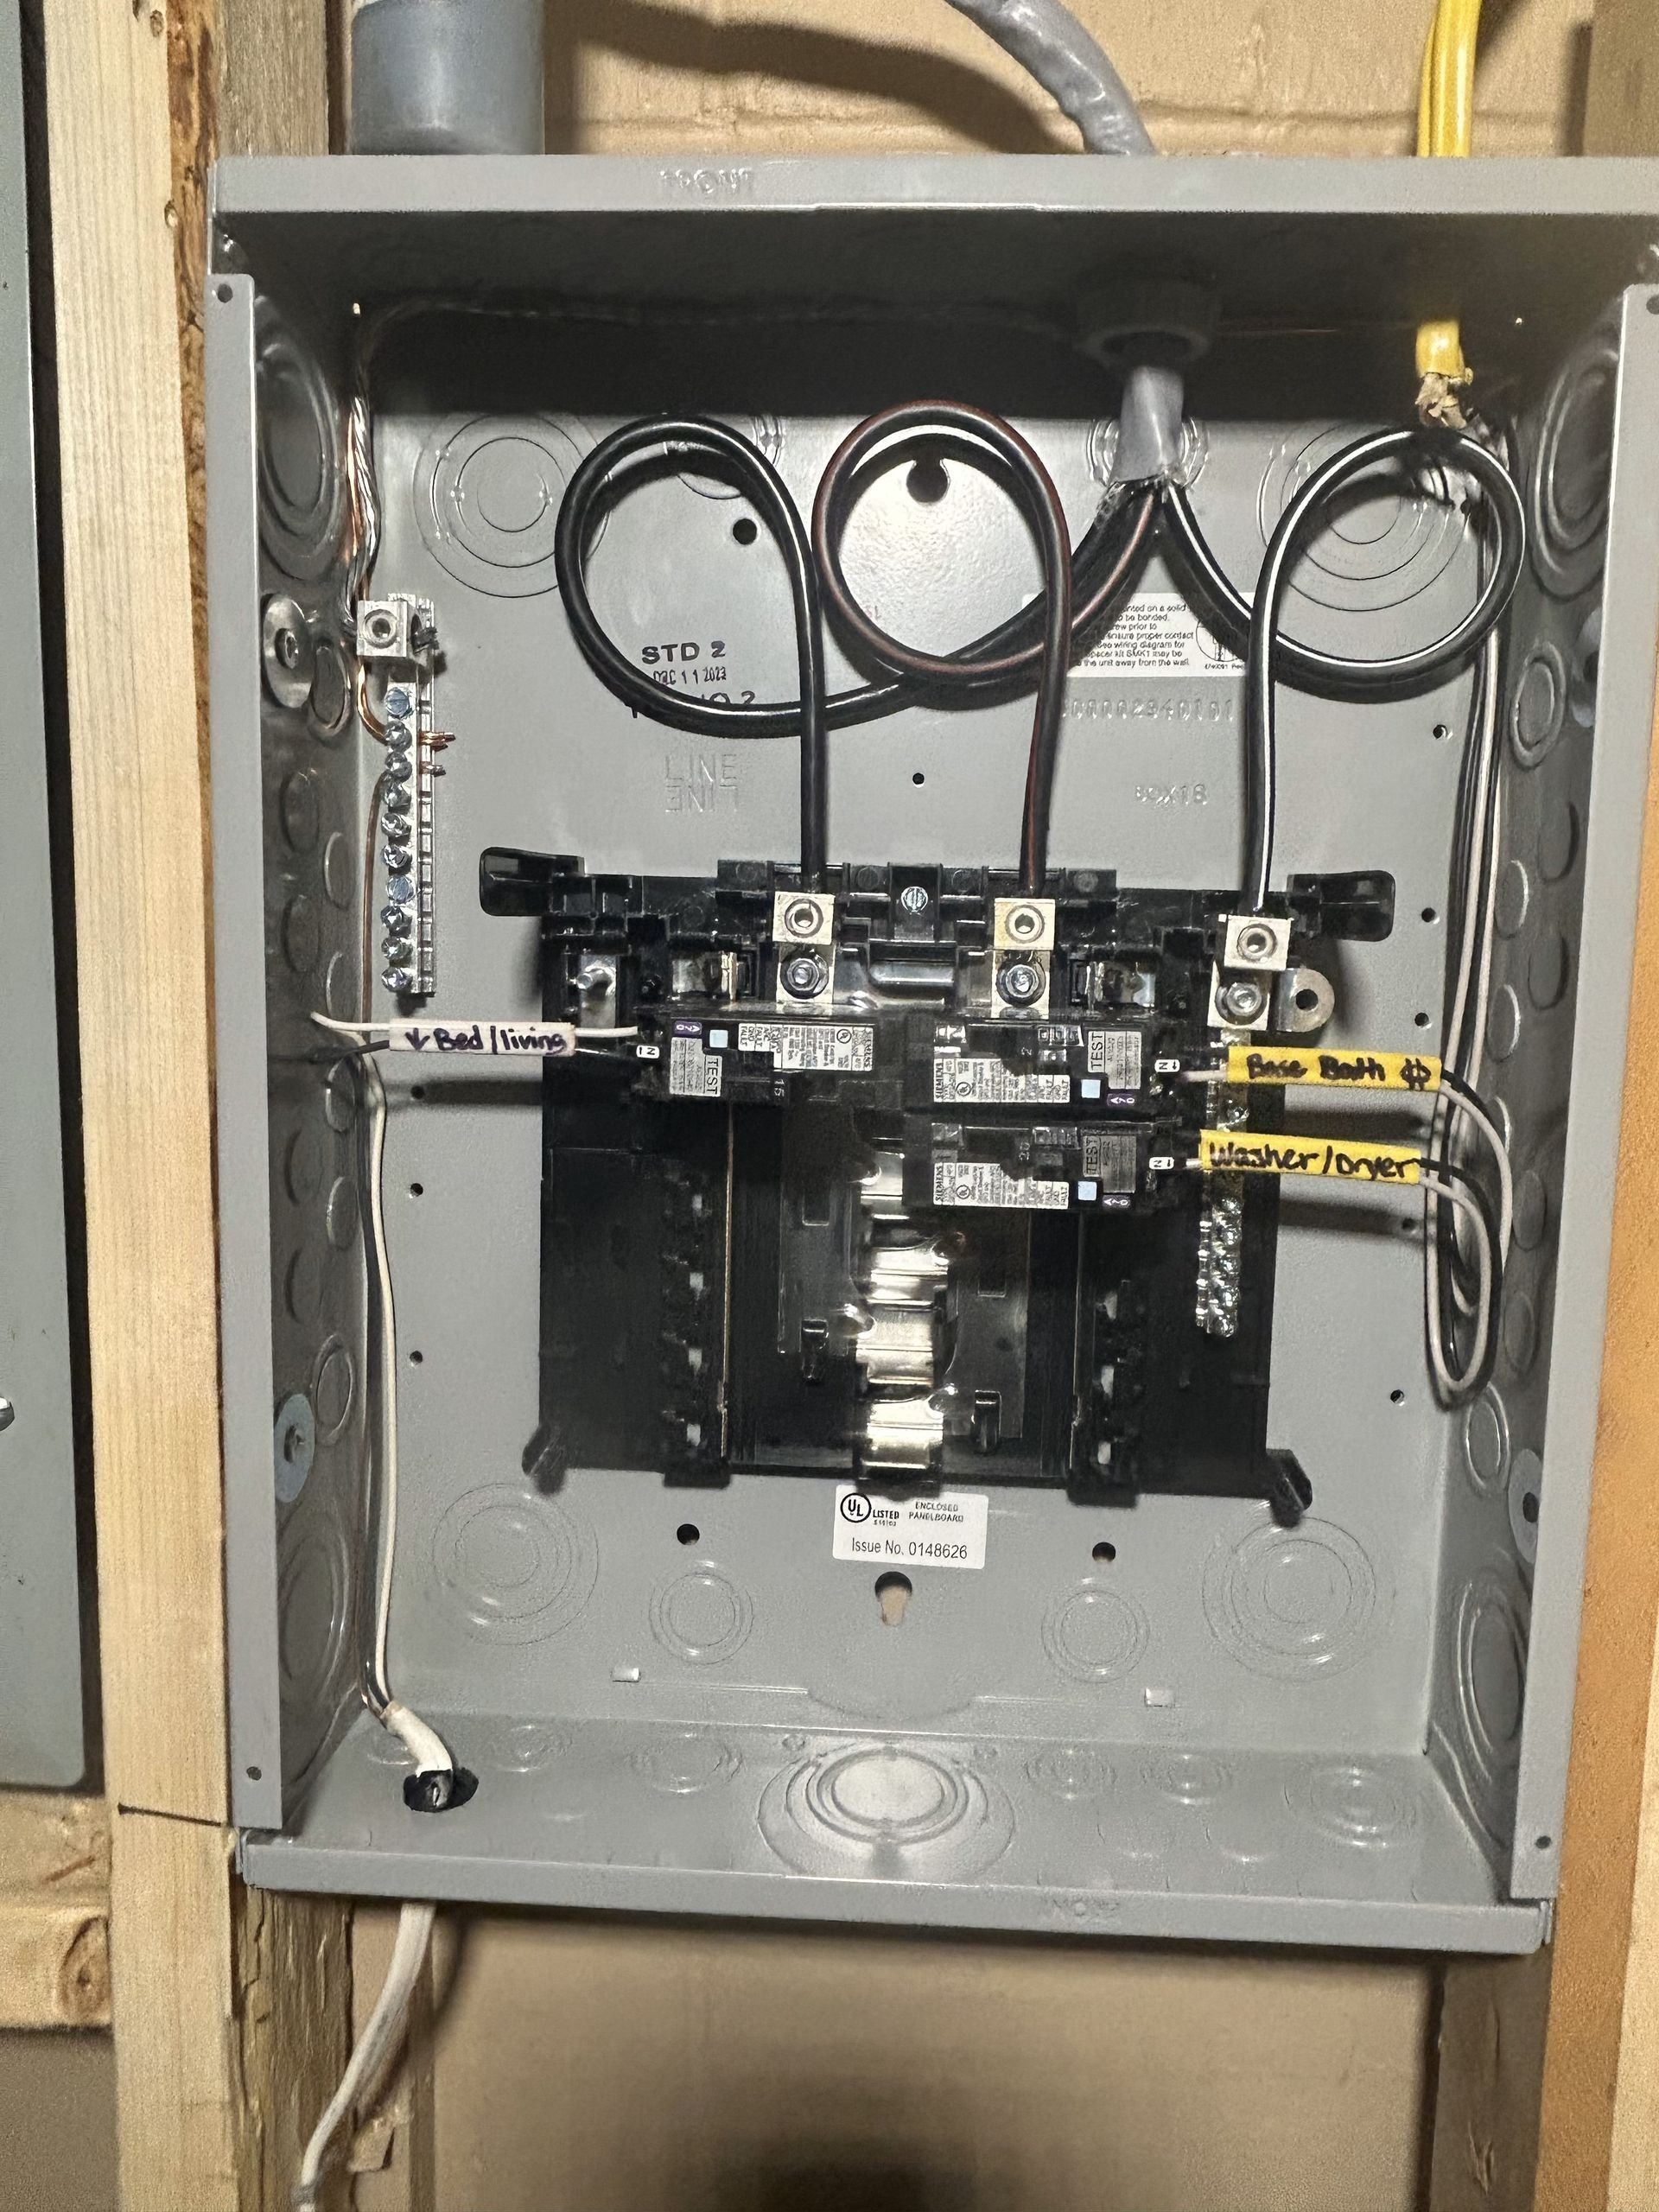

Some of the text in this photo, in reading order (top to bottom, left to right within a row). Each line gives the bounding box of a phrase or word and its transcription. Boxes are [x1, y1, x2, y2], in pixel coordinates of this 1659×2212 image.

[1128, 623, 1148, 632] prior
[1136, 632, 1162, 641] proper
[1114, 641, 1137, 650] wiring
[1140, 640, 1173, 650] diagram
[641, 640, 726, 664] STD 2
[1116, 659, 1136, 668] away
[1139, 658, 1156, 667] from
[1090, 1032, 1104, 1071] TEST
[705, 1058, 719, 1095] TEST
[1086, 1137, 1100, 1176] TEST
[915, 1501, 959, 1512] ENCLOSED
[873, 1510, 899, 1520] LISTED
[908, 1512, 964, 1522] PANELBOARD
[852, 1537, 968, 1560] Issue No. 0148626
